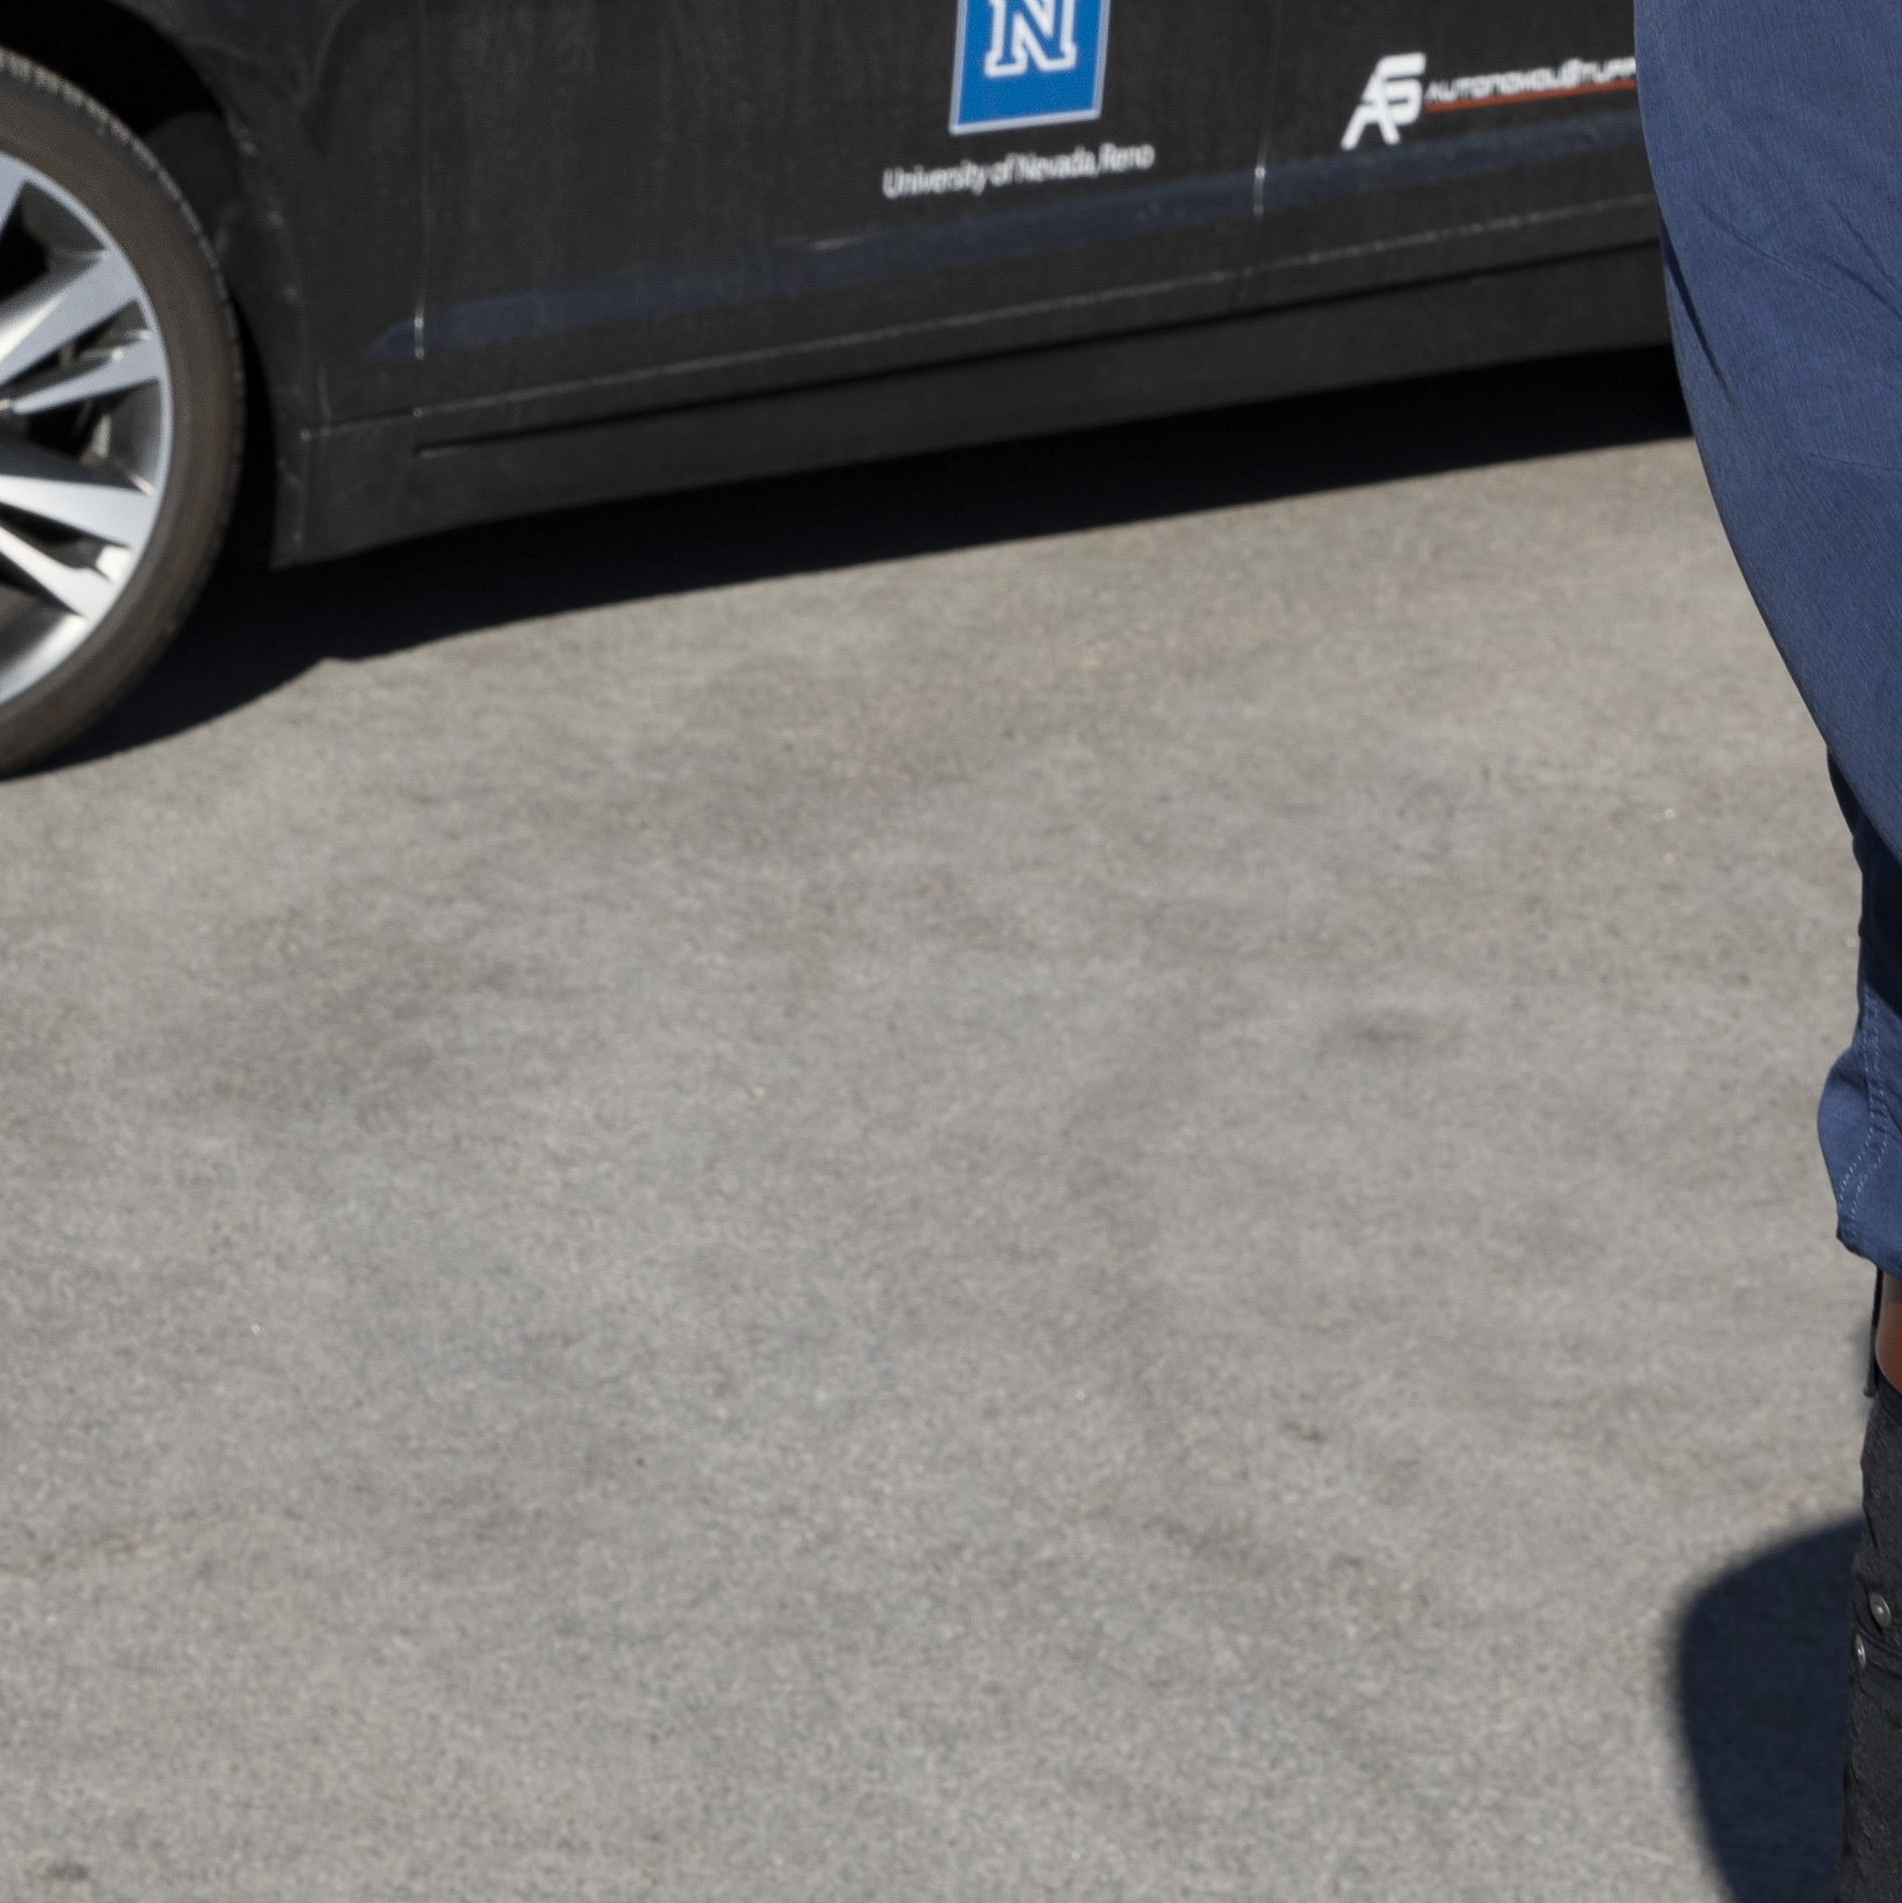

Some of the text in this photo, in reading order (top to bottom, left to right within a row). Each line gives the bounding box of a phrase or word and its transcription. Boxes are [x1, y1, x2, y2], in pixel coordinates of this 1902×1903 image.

[882, 158, 987, 199] University
[988, 152, 1015, 187] of
[1098, 141, 1156, 174] Reno
